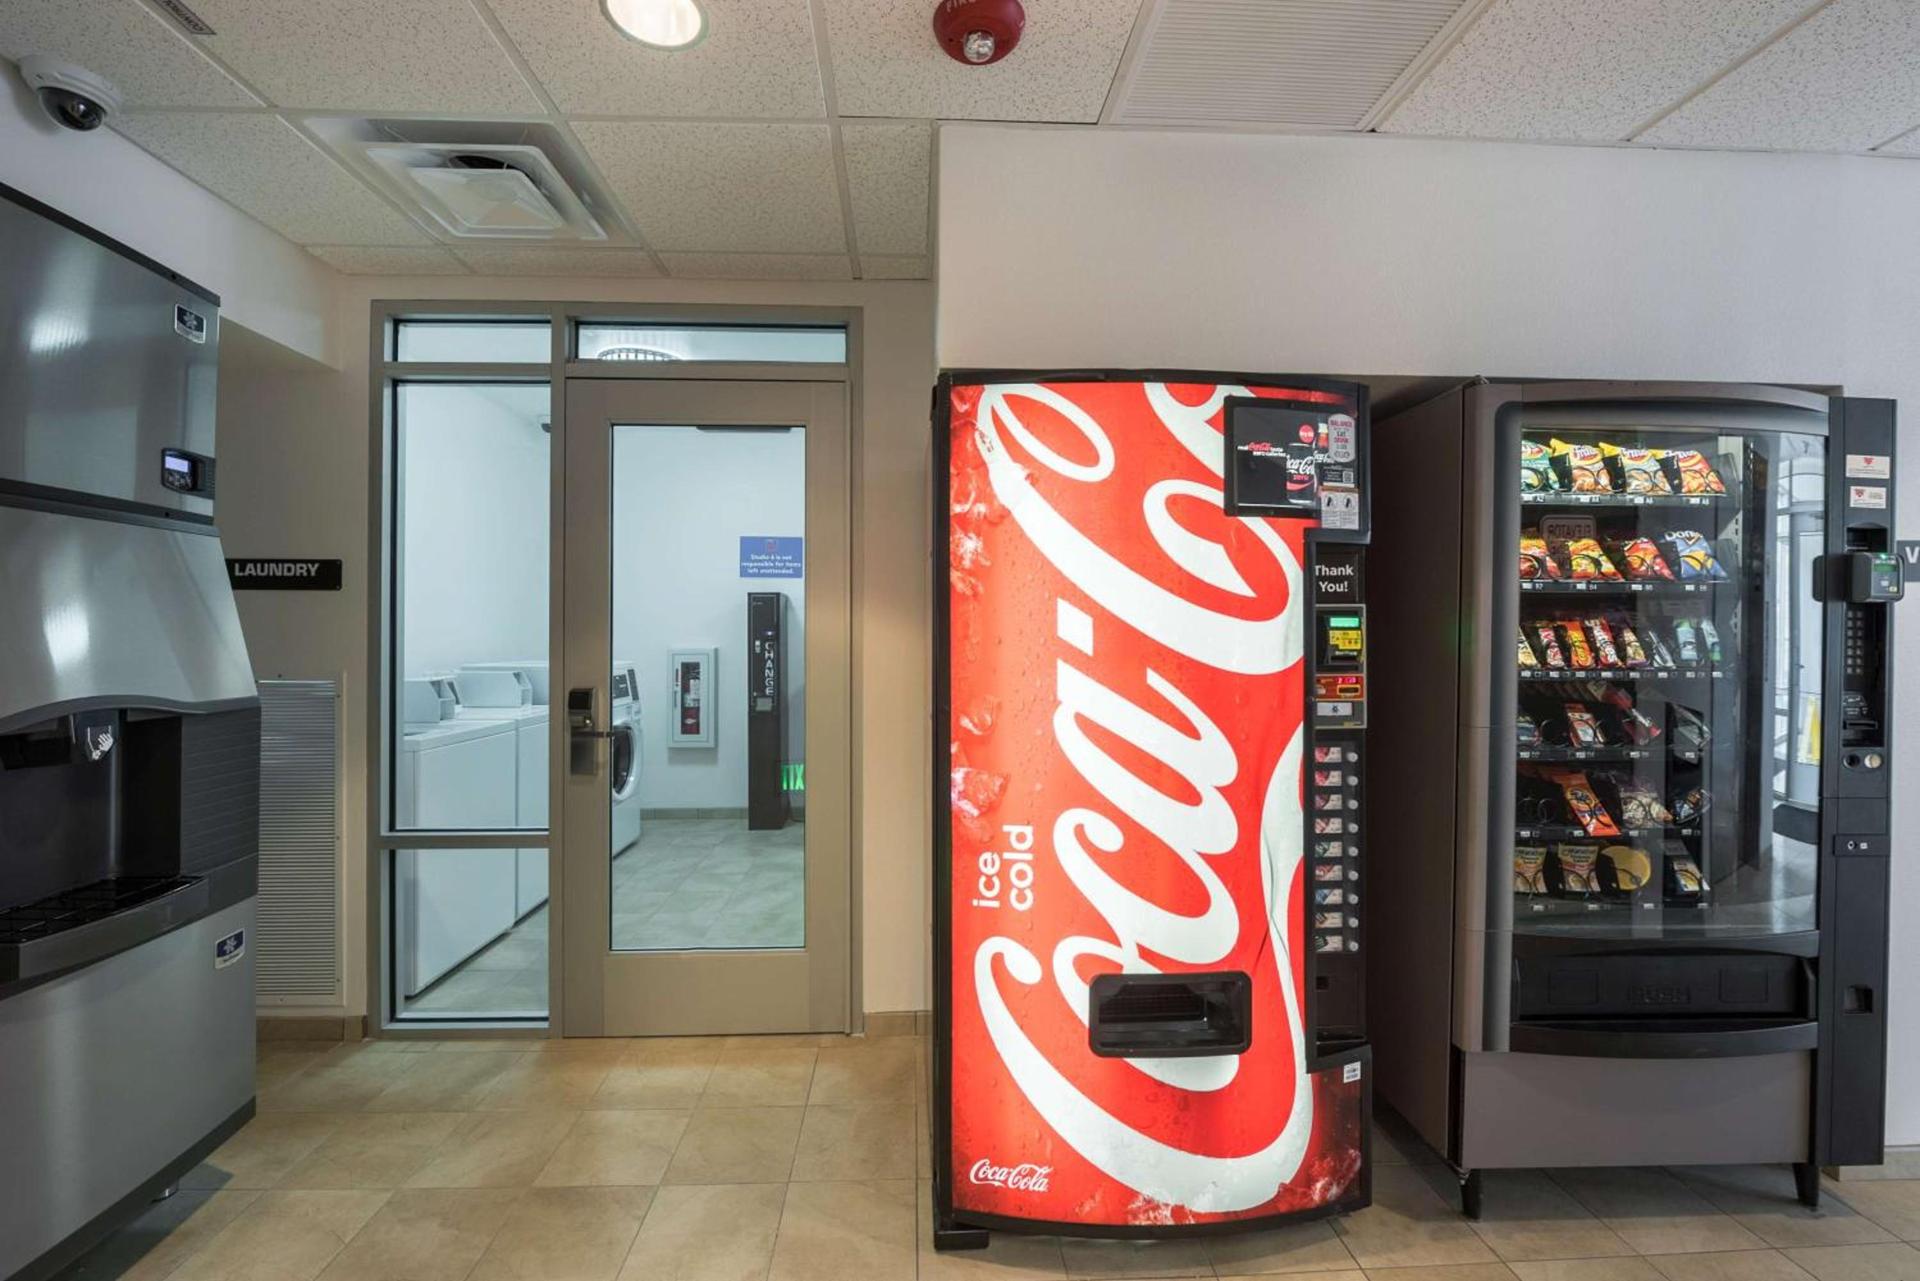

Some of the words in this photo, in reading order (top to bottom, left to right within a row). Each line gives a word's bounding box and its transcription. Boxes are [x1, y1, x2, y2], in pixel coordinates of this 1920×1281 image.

[234, 562, 320, 577] LAUNDRY
[1314, 564, 1354, 576] Thank
[1318, 580, 1348, 592] You!
[764, 641, 774, 696] CHANGE
[972, 851, 1001, 908] ice
[1002, 824, 1034, 911] cold
[969, 1158, 1053, 1193] Coca-Cola
